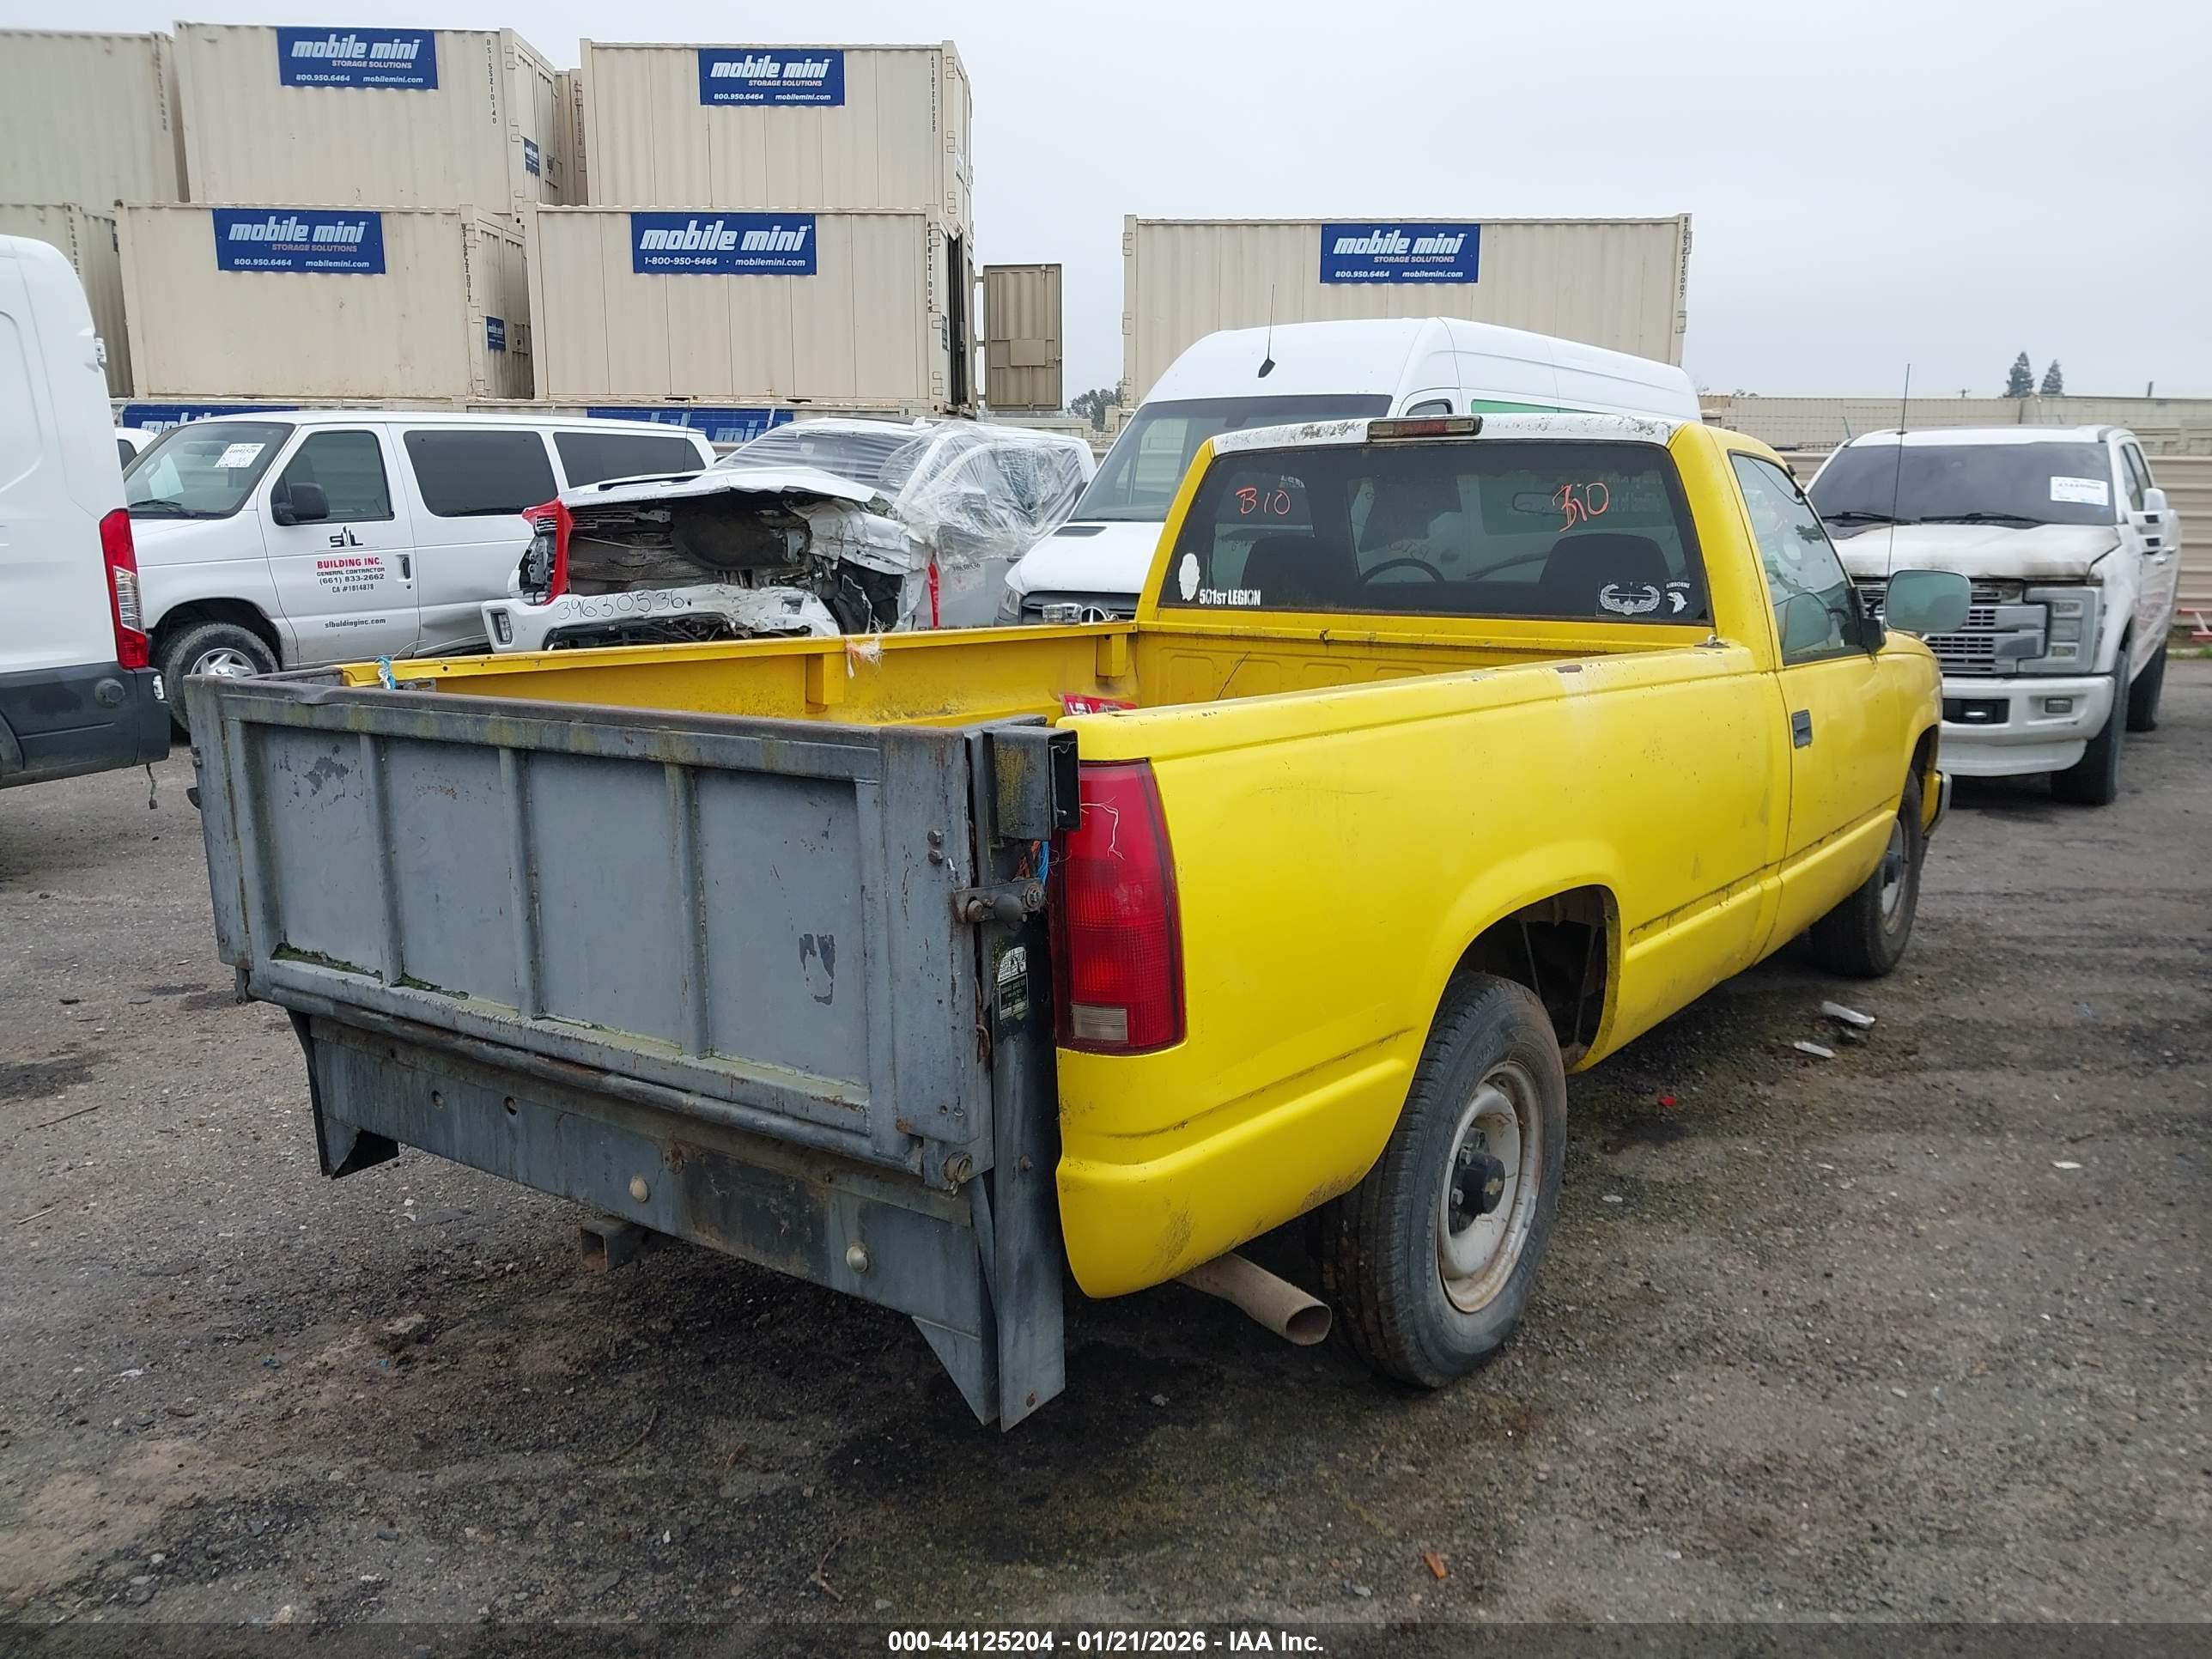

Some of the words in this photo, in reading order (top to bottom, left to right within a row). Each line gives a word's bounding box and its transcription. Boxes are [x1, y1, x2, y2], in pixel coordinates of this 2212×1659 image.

[291, 33, 368, 58] mobile
[369, 39, 420, 60] mini
[709, 55, 781, 78] mobile
[782, 58, 830, 78] mini
[362, 75, 423, 83] mobilemini.com
[228, 216, 309, 242] mobile
[312, 221, 367, 243] mini
[639, 220, 738, 251] mobile
[740, 225, 808, 252] mini
[271, 243, 310, 252] STORAGE
[1333, 229, 1411, 255] mobile
[1412, 233, 1466, 254] mini
[305, 259, 370, 268] mobilemini.com
[644, 257, 718, 265] 1-800-950-6464
[735, 258, 806, 267] mobilemini.com
[317, 558, 362, 569] BUILDING
[364, 556, 383, 566] INC.
[345, 567, 386, 575] CONTRACTOR
[319, 576, 343, 586] (661)
[344, 574, 385, 583] 833-2662
[556, 589, 685, 620] 39630536
[1227, 589, 1261, 606] LEGION
